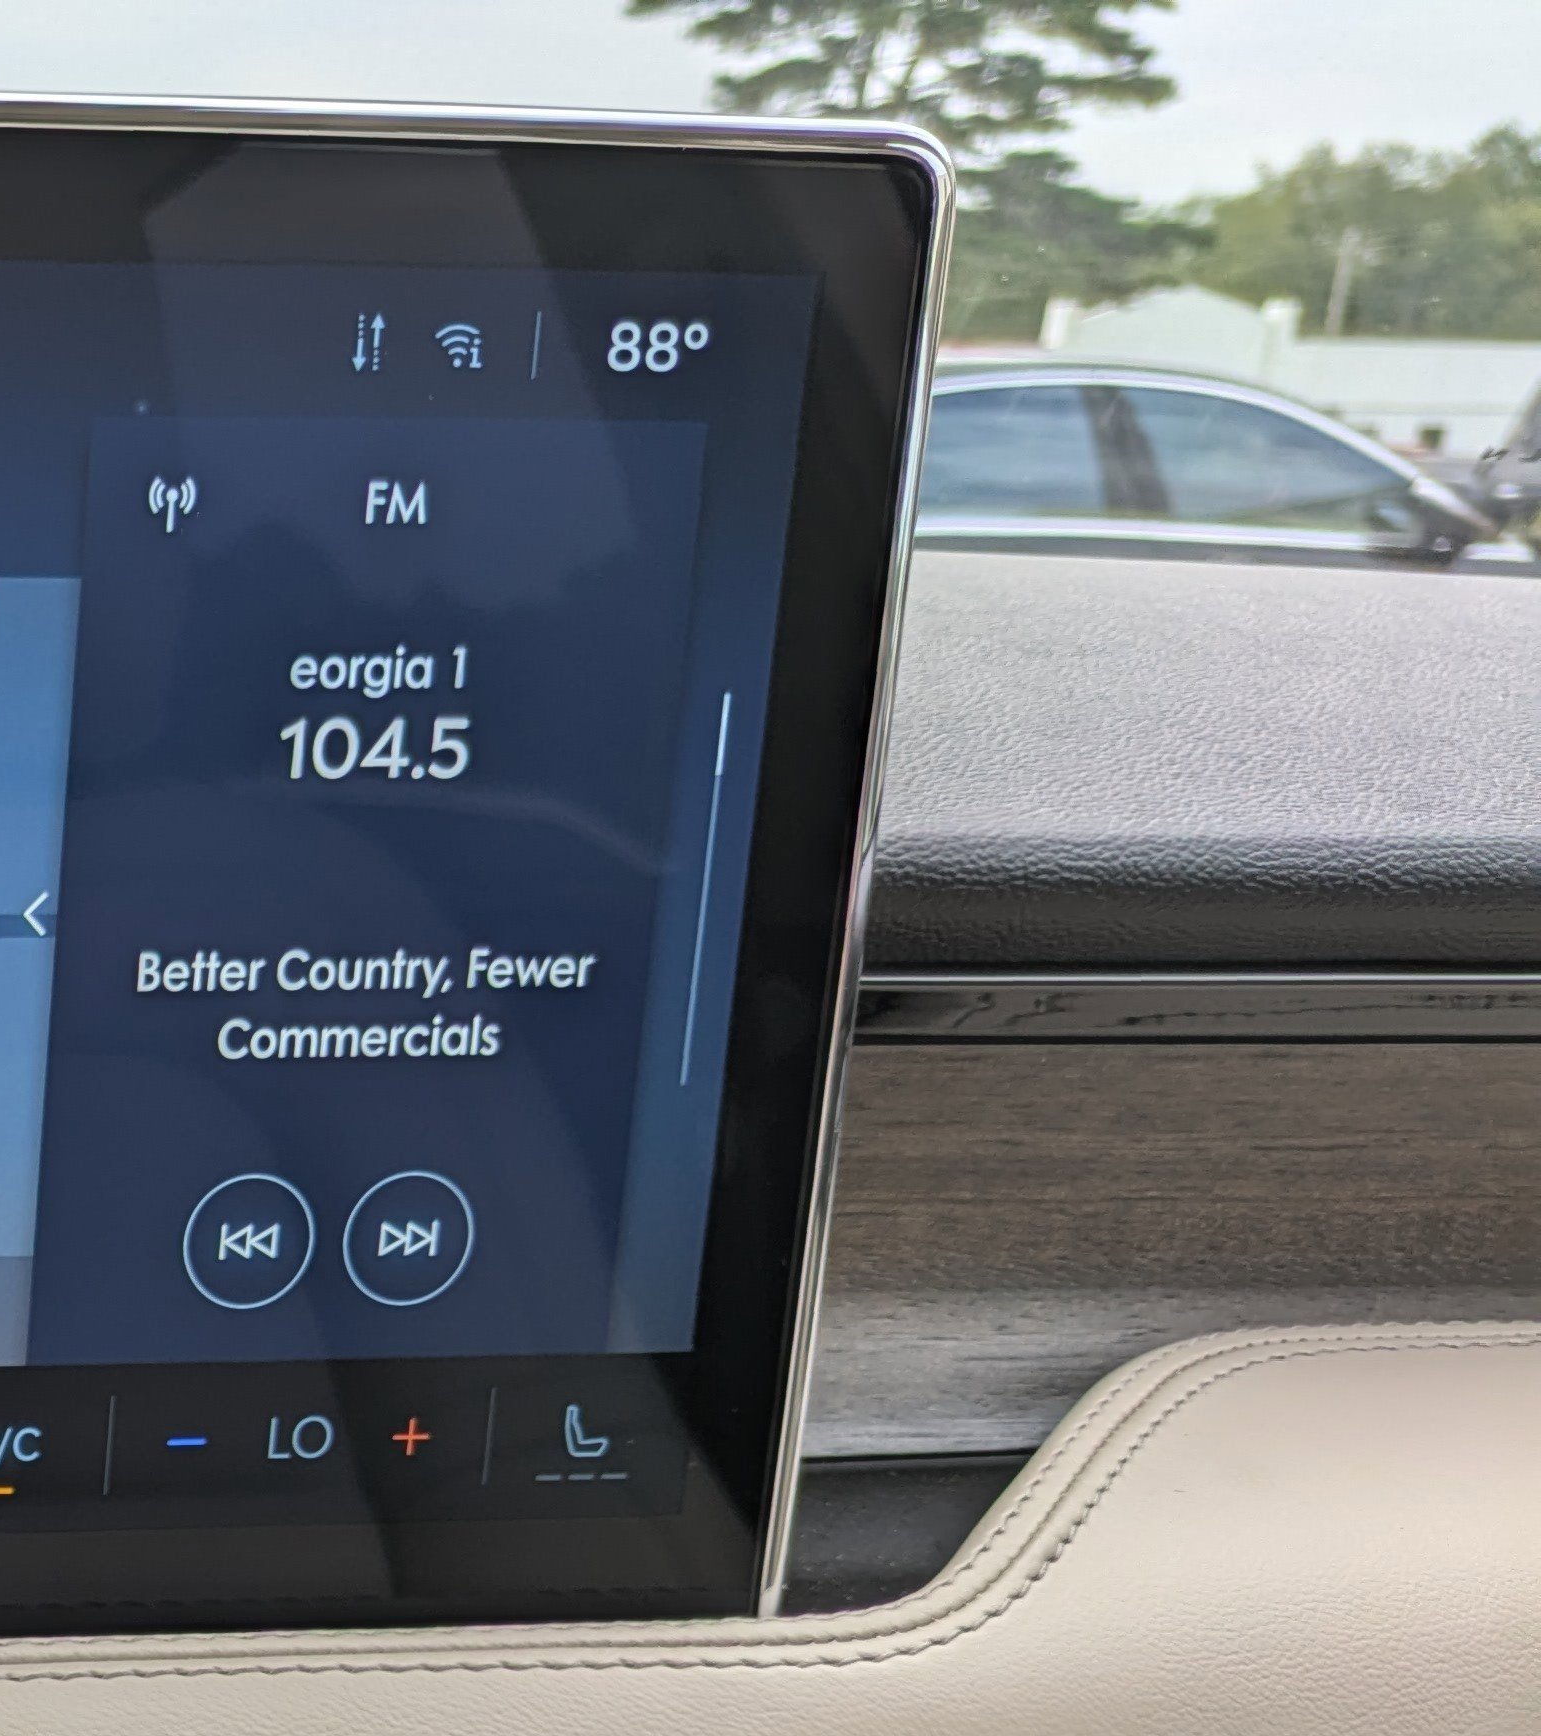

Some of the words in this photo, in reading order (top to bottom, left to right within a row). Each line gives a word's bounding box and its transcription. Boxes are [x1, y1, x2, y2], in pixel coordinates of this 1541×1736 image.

[606, 320, 710, 374] 88°
[364, 479, 427, 526] FM
[289, 644, 435, 700] eorgia
[452, 645, 468, 690] 1
[279, 715, 471, 781] 104.5
[136, 950, 267, 993] Better
[276, 947, 454, 1000] Country,
[465, 946, 597, 990] Fewer
[217, 1013, 501, 1061] Commercials
[266, 1414, 334, 1460] LO
